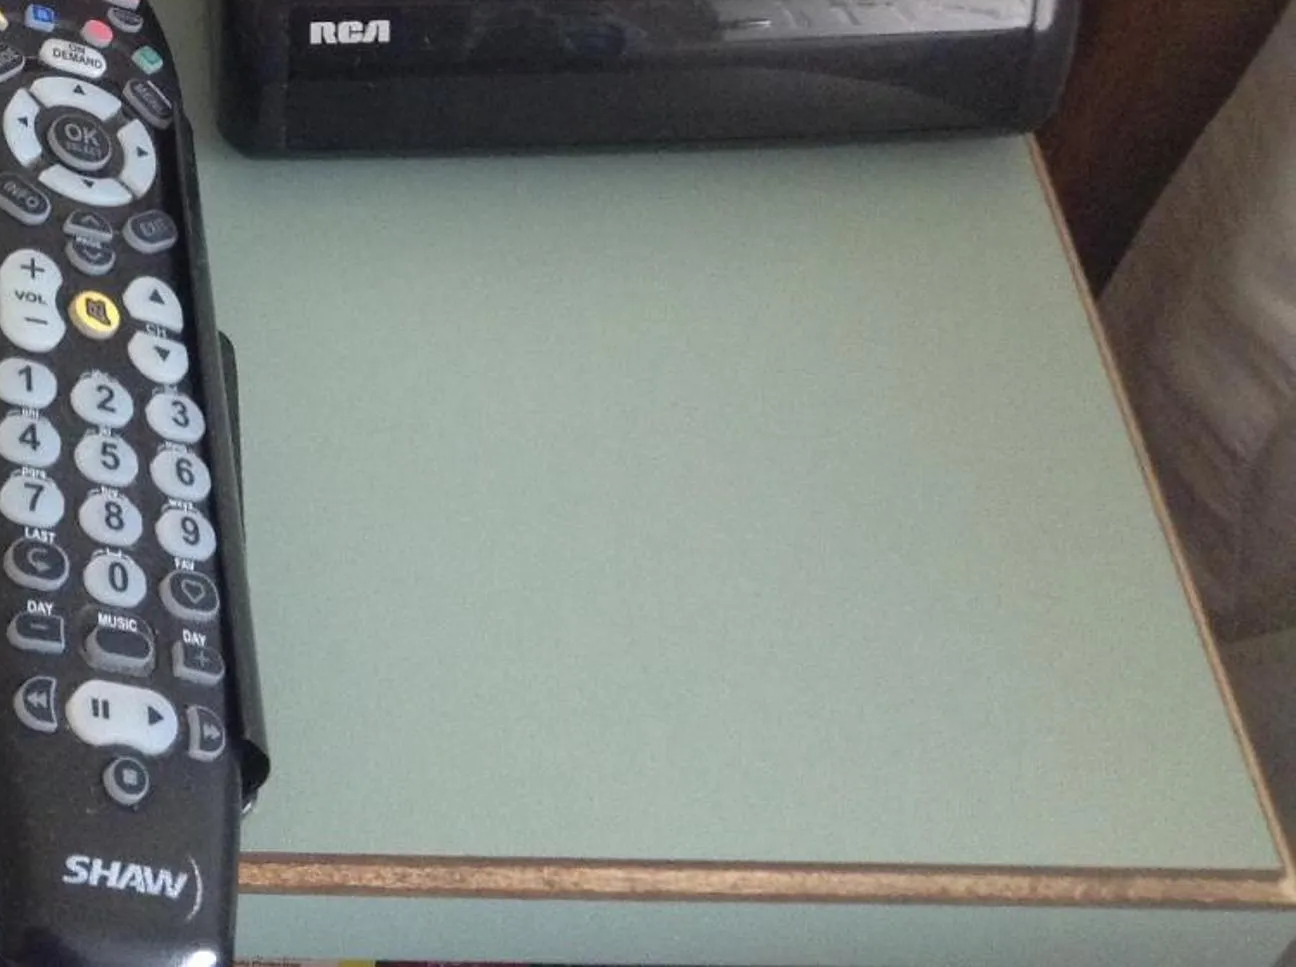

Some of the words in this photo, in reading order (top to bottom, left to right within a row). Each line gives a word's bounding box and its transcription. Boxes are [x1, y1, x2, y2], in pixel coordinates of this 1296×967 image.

[309, 19, 391, 45] RCA
[52, 47, 104, 70] DEMAND
[64, 122, 102, 147] OK
[3, 182, 41, 209] INFO
[15, 289, 49, 305] VOL
[18, 365, 34, 393] 1
[96, 384, 117, 414] 2
[171, 400, 191, 429] 3
[18, 423, 41, 452] 4
[100, 443, 121, 472] 5
[175, 457, 196, 487] 6
[23, 482, 45, 512] 7
[104, 501, 125, 531] 8
[24, 526, 56, 543] LAST
[180, 516, 201, 546] 9
[108, 562, 129, 593] 0
[27, 600, 54, 616] DAY
[97, 612, 138, 633] MUSIC
[182, 629, 207, 647] DAY
[61, 854, 190, 901] SHAW
